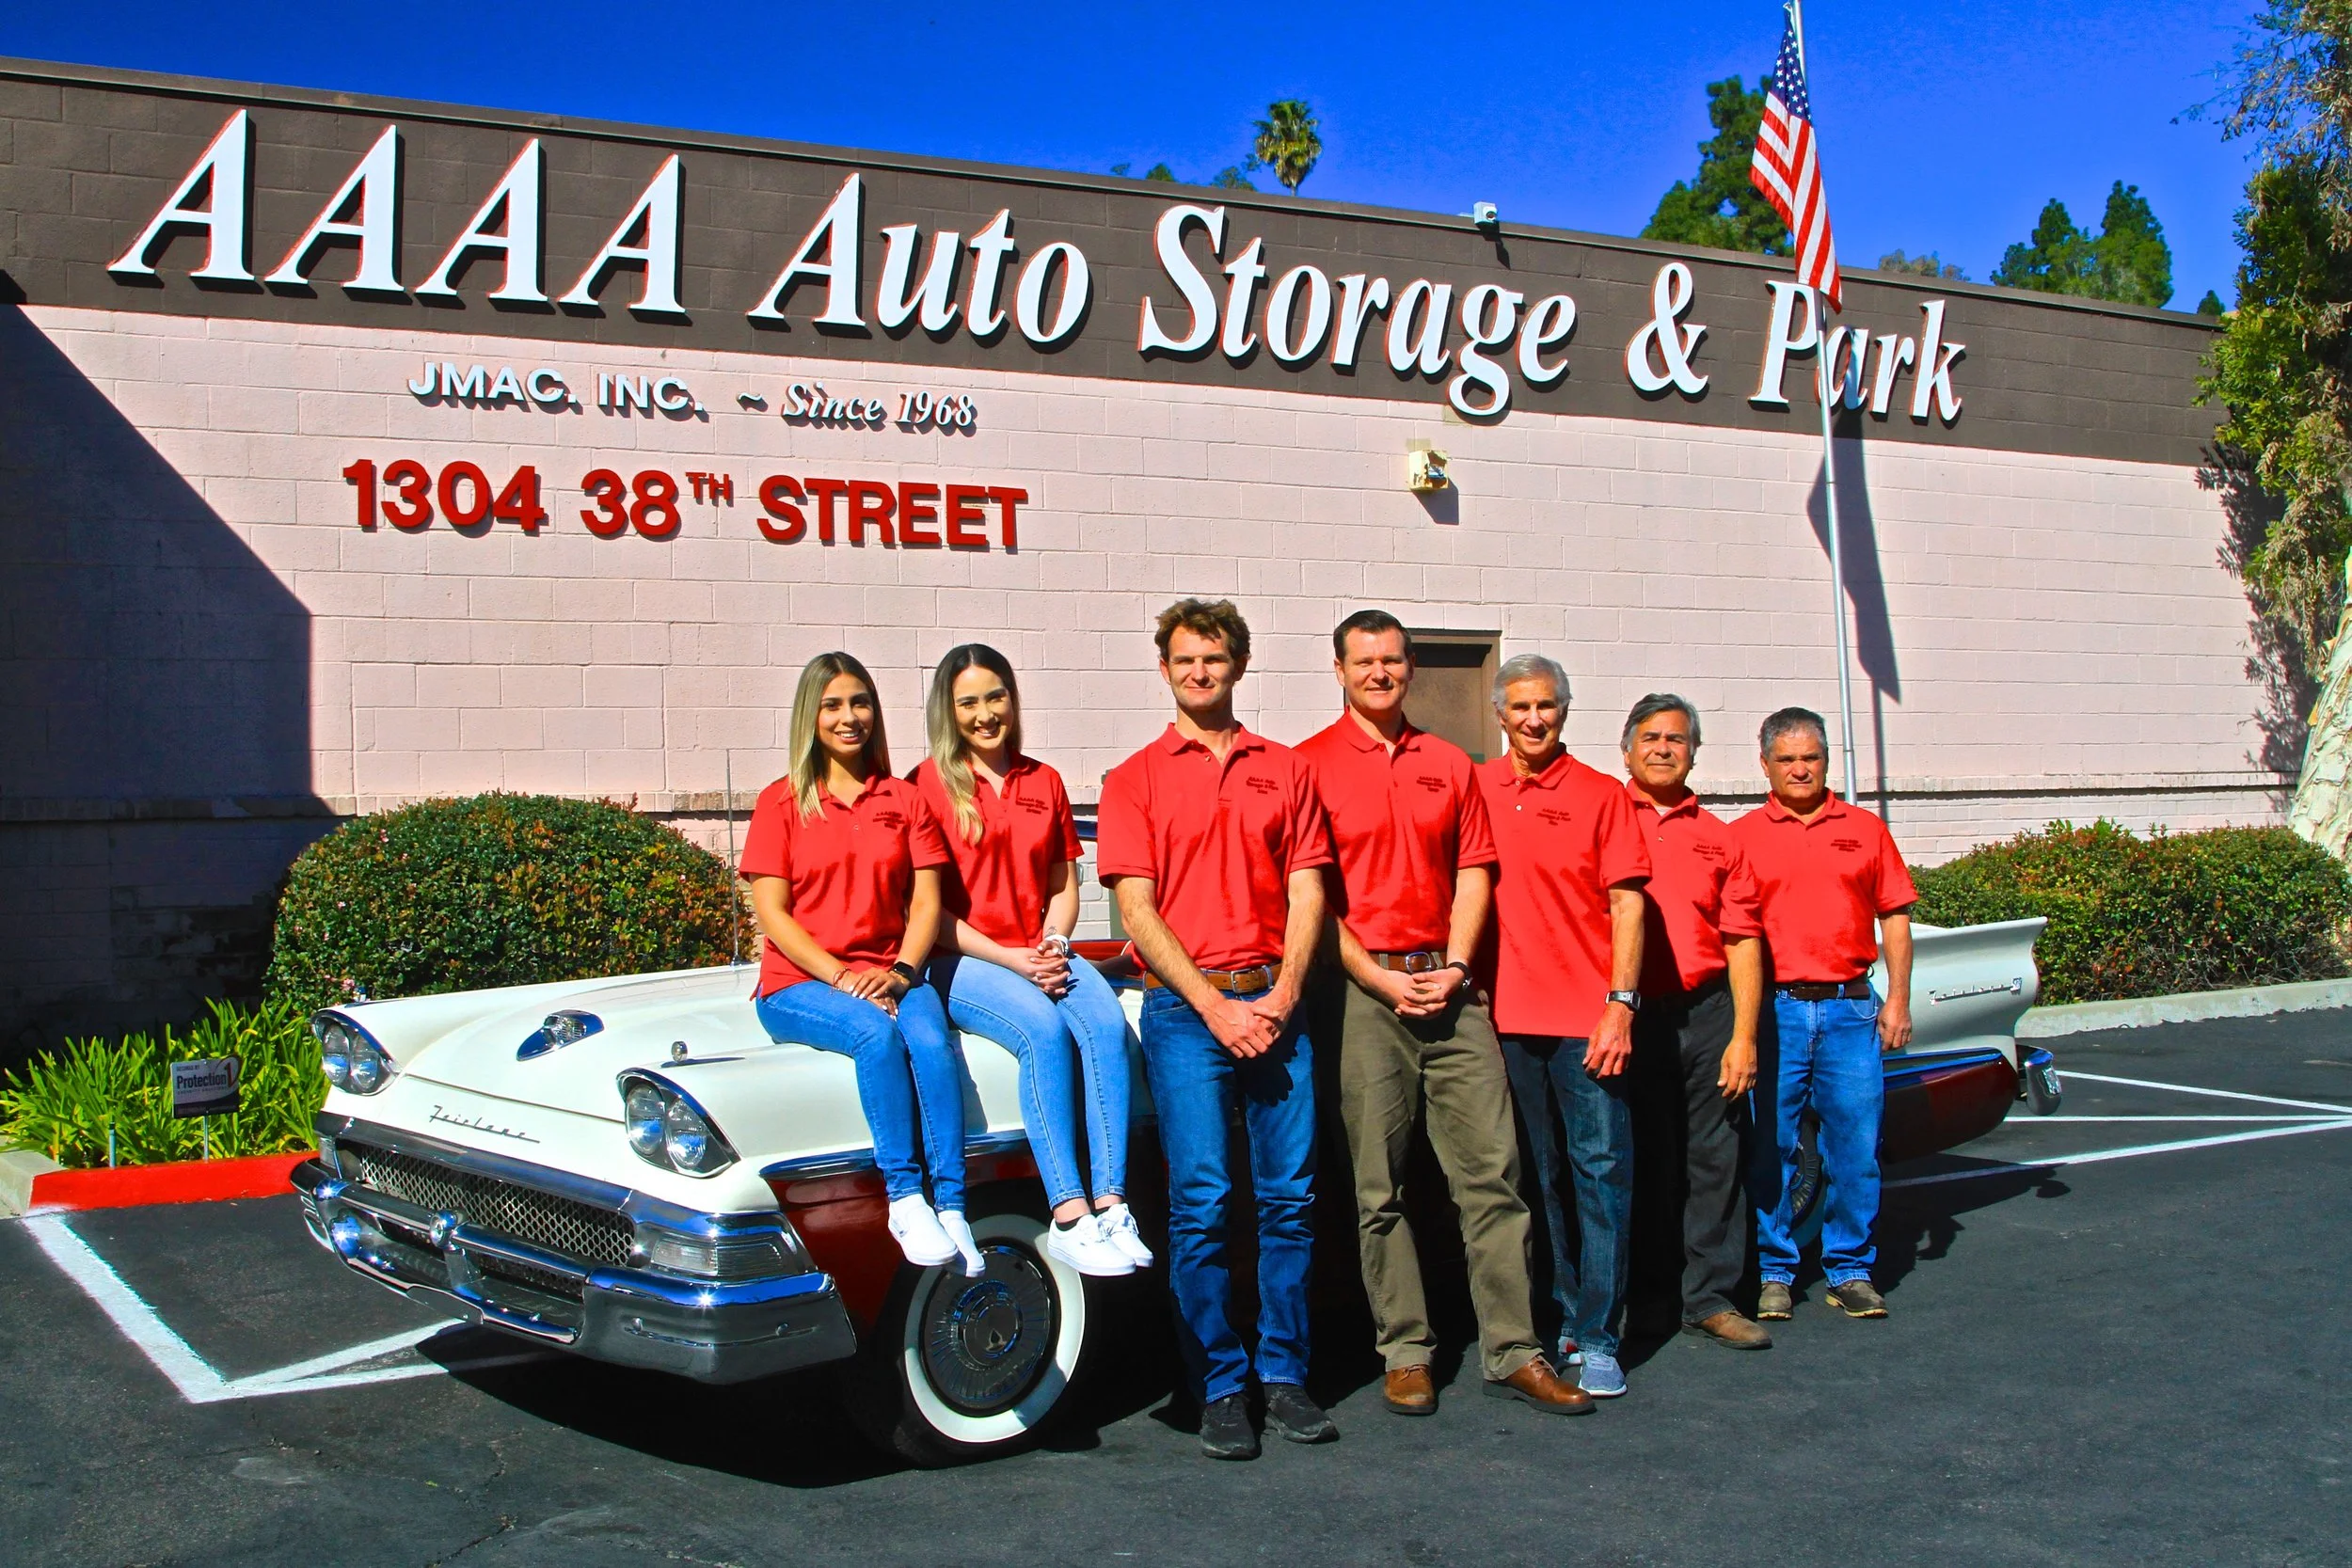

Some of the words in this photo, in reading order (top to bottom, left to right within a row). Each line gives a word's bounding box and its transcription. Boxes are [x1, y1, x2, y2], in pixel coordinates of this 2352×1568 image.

[747, 171, 1089, 343] Auto
[1137, 203, 1577, 417] Storage
[1625, 261, 1709, 394] &
[1747, 279, 1966, 421] Park
[407, 361, 578, 404] JMAC.
[596, 372, 705, 412] INC.
[781, 381, 883, 421] Since
[897, 389, 975, 427] 1968
[342, 459, 546, 531] 1304
[756, 474, 1029, 549] STREET
